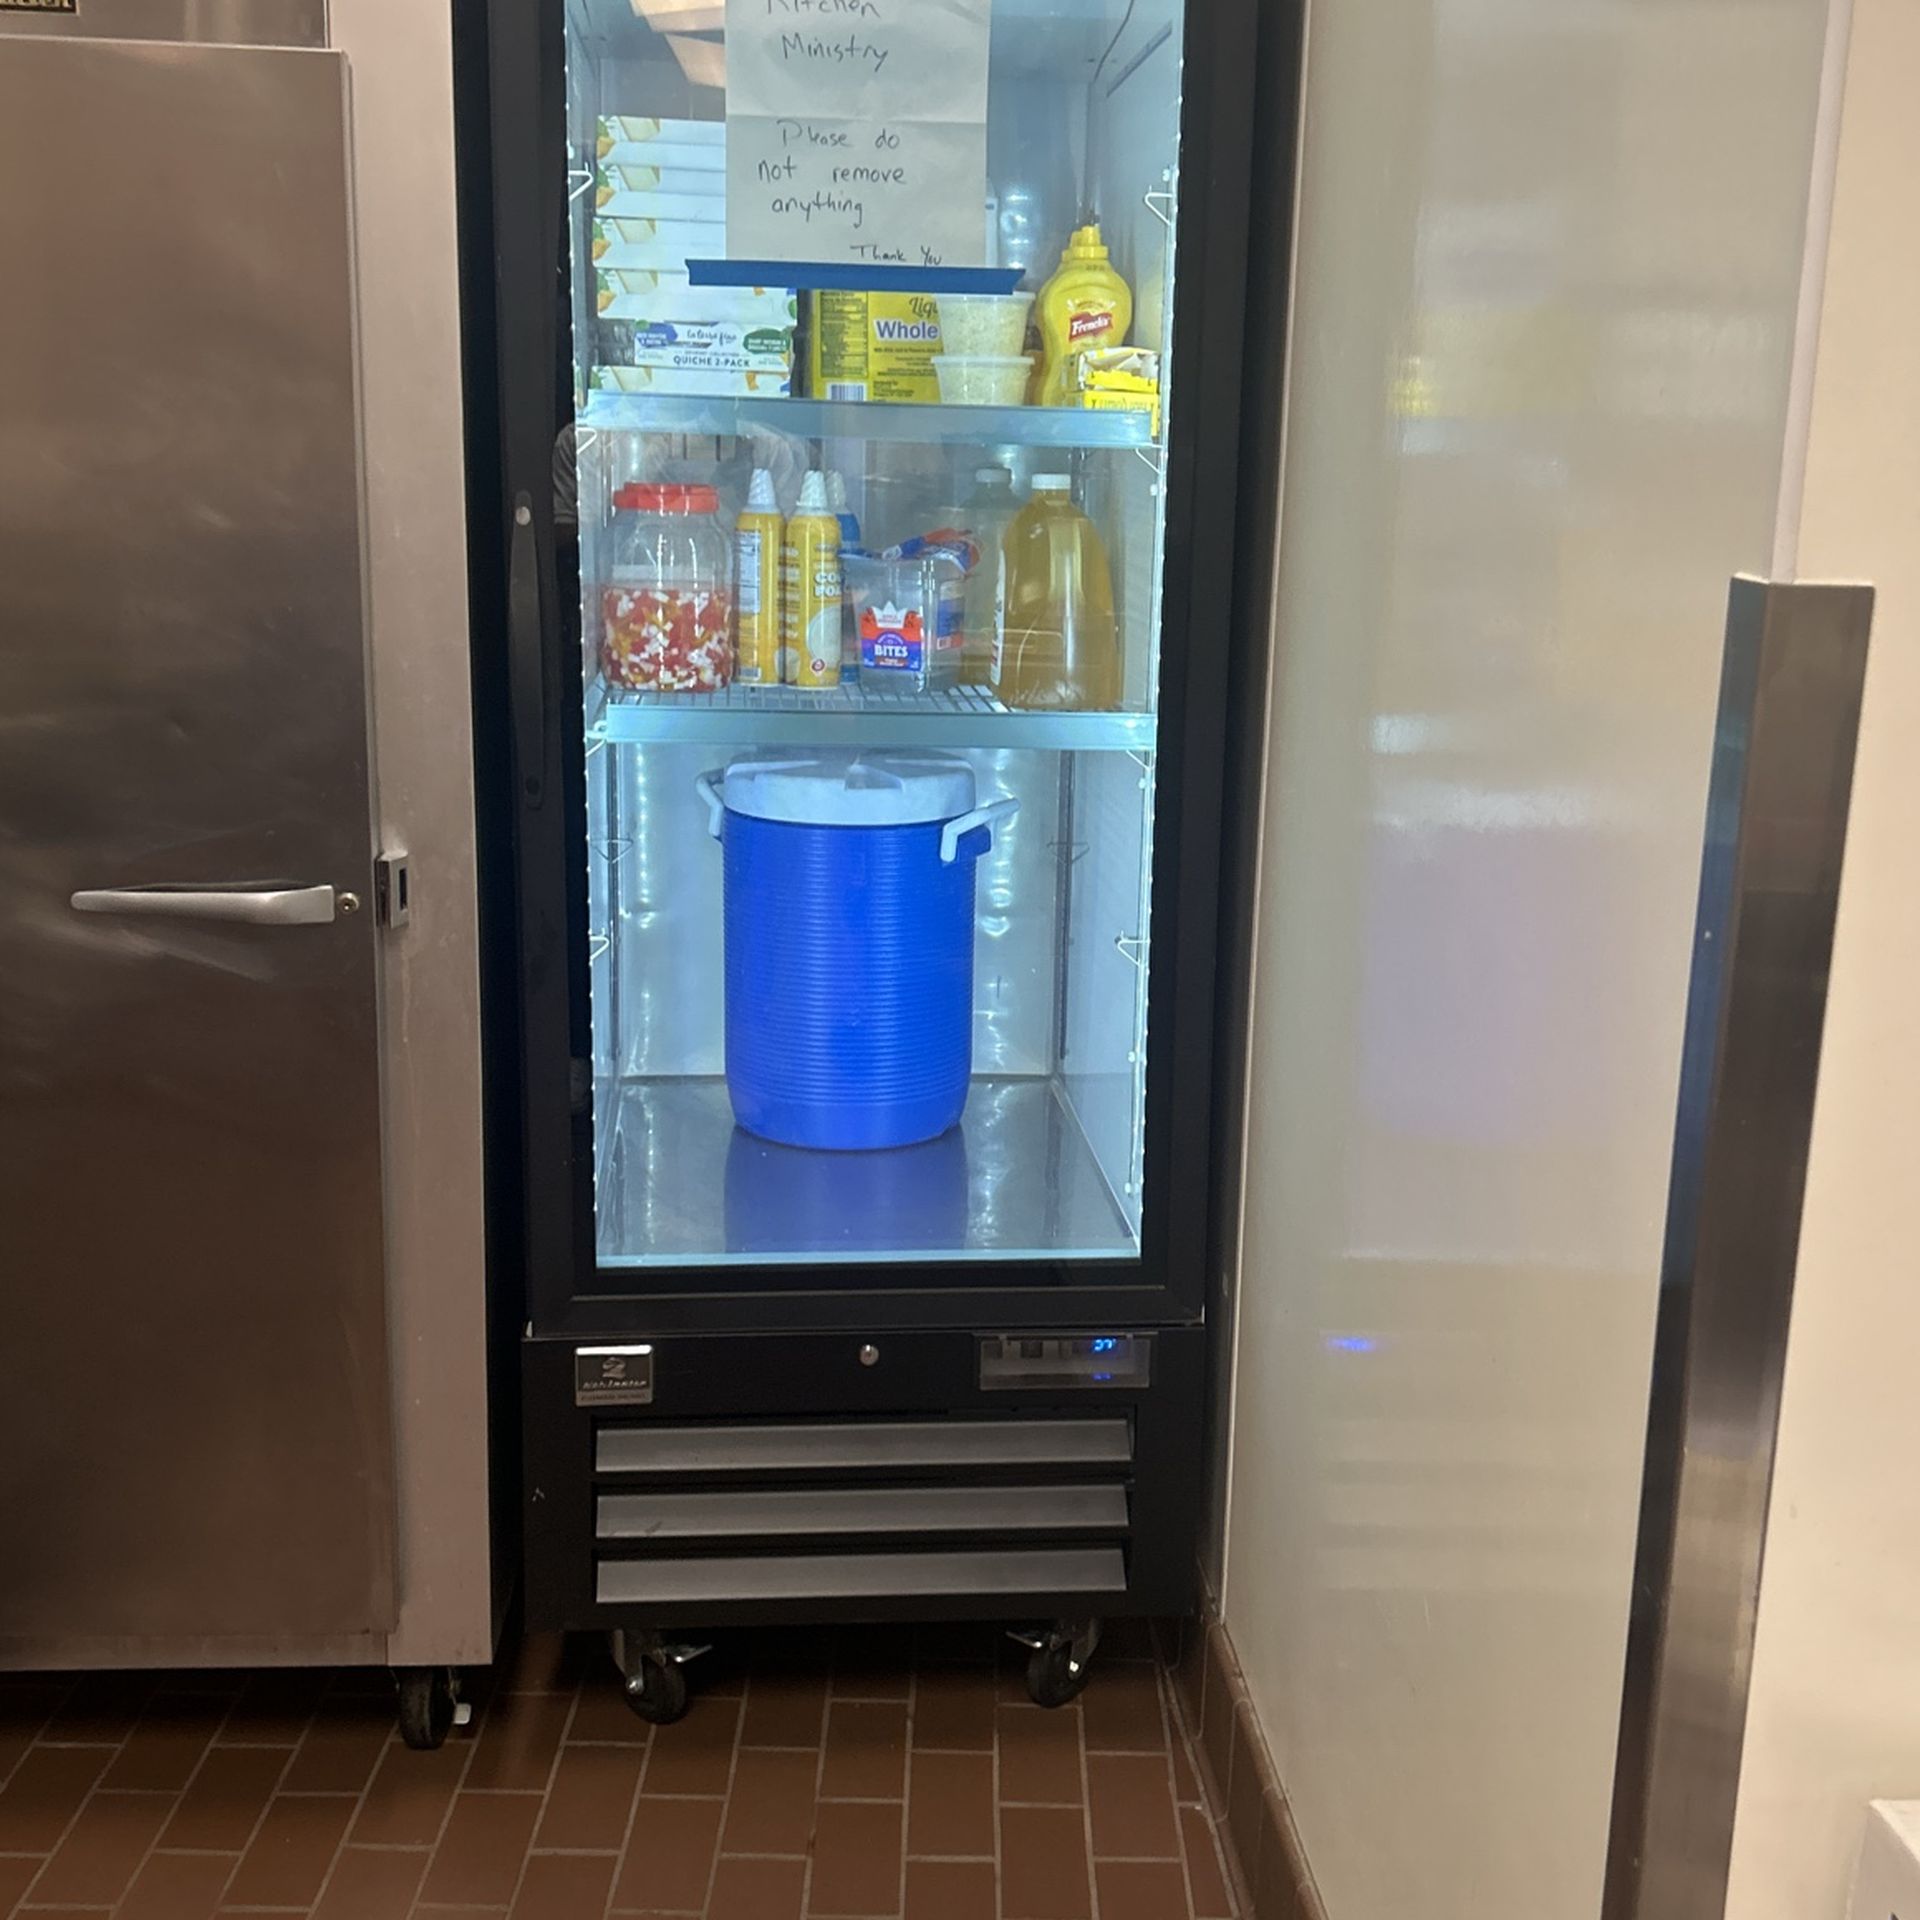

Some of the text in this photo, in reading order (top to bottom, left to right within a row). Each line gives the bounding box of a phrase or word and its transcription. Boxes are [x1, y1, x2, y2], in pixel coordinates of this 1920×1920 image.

[781, 32, 889, 73] Ministry
[776, 118, 901, 150] Please do
[757, 154, 905, 184] not remove
[771, 190, 864, 230] anything
[849, 243, 943, 268] Thank You
[876, 320, 939, 340] Whole
[672, 354, 713, 367] QUICHE
[714, 356, 752, 369] 2-PACK
[873, 643, 909, 658] BITES
